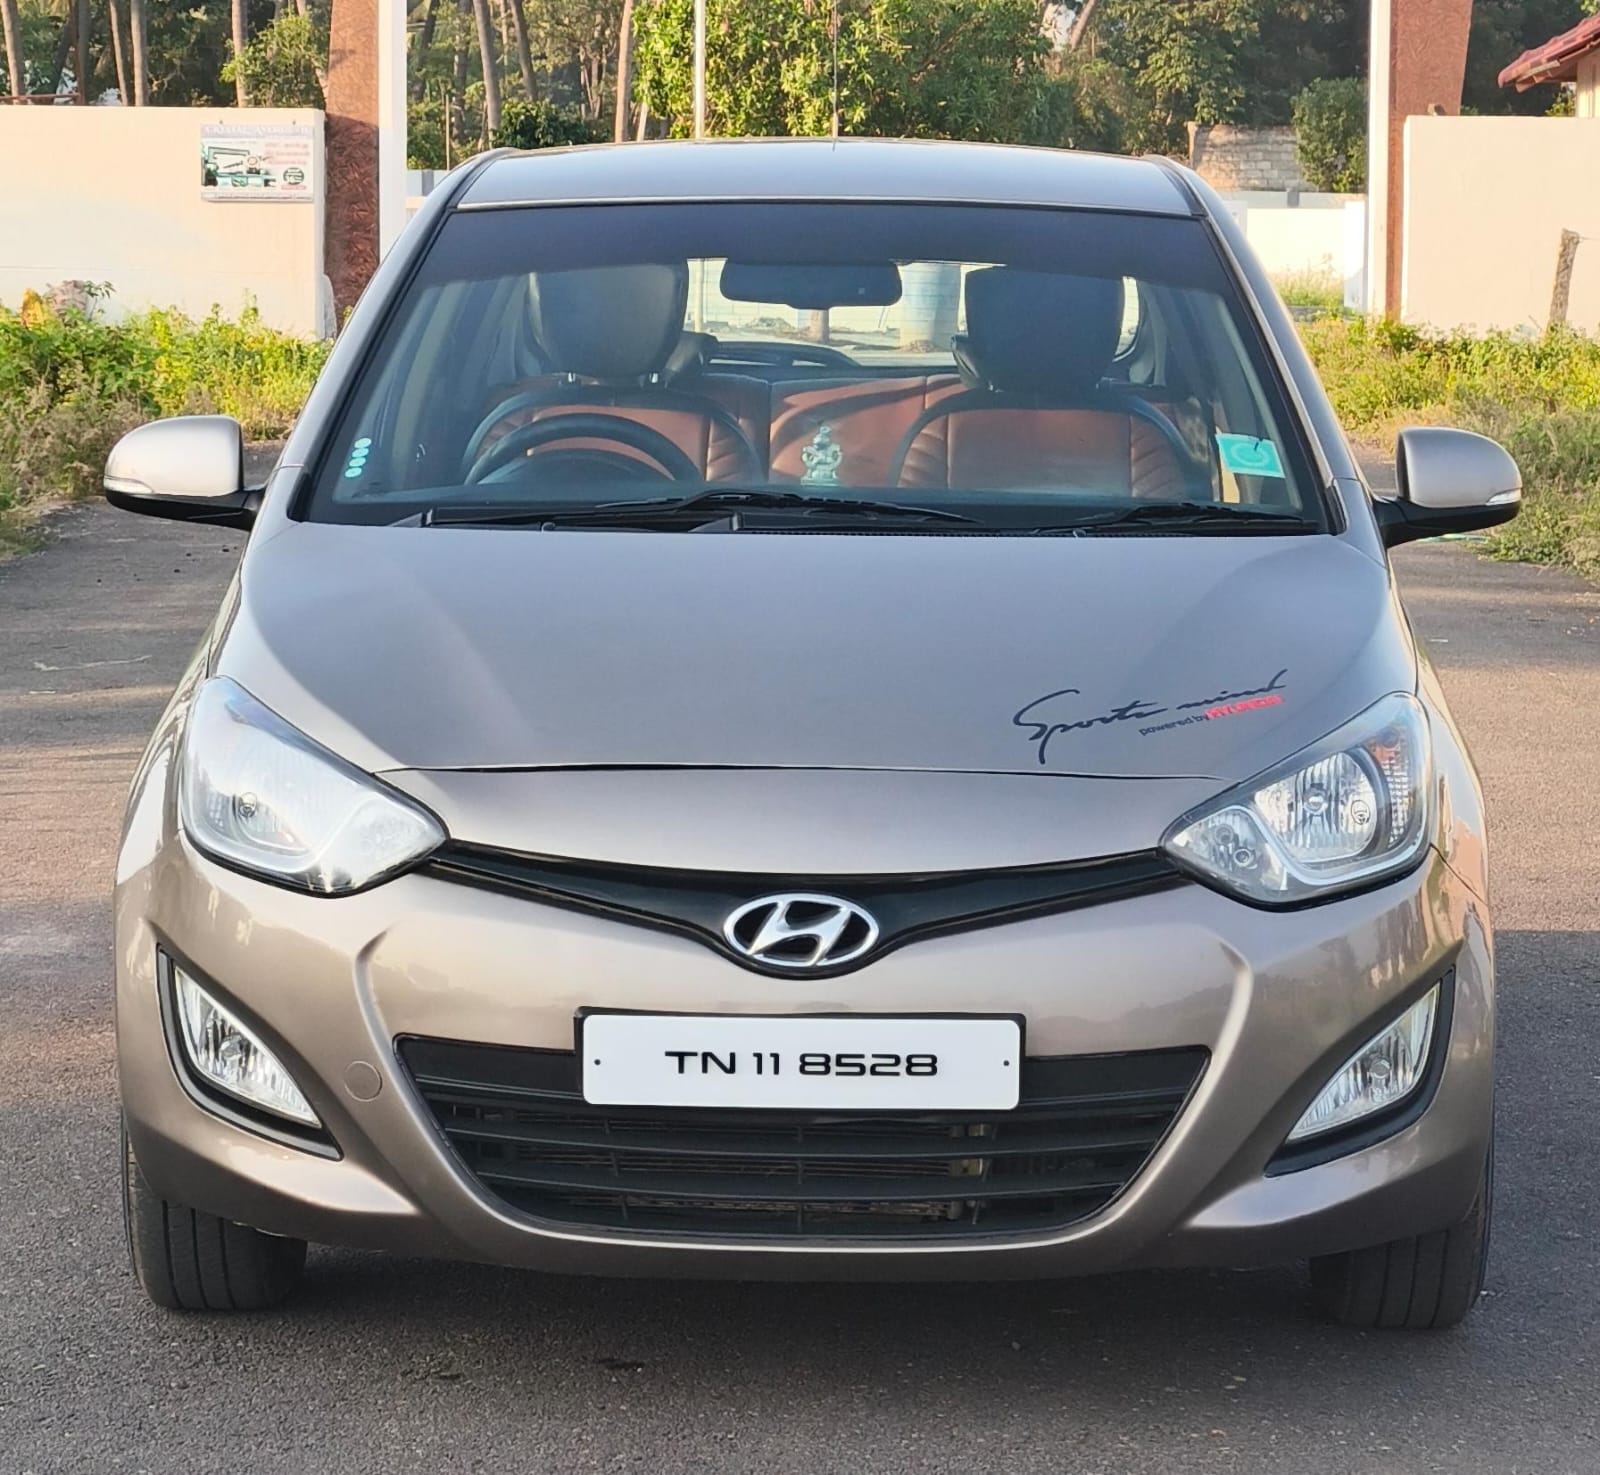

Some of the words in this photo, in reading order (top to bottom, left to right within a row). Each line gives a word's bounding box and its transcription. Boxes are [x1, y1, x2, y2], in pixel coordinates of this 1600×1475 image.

[1013, 689, 1168, 764] Sports
[1138, 716, 1193, 736] powered
[664, 1051, 735, 1075] TN
[752, 1052, 780, 1075] 11
[799, 1053, 938, 1076] 8528
